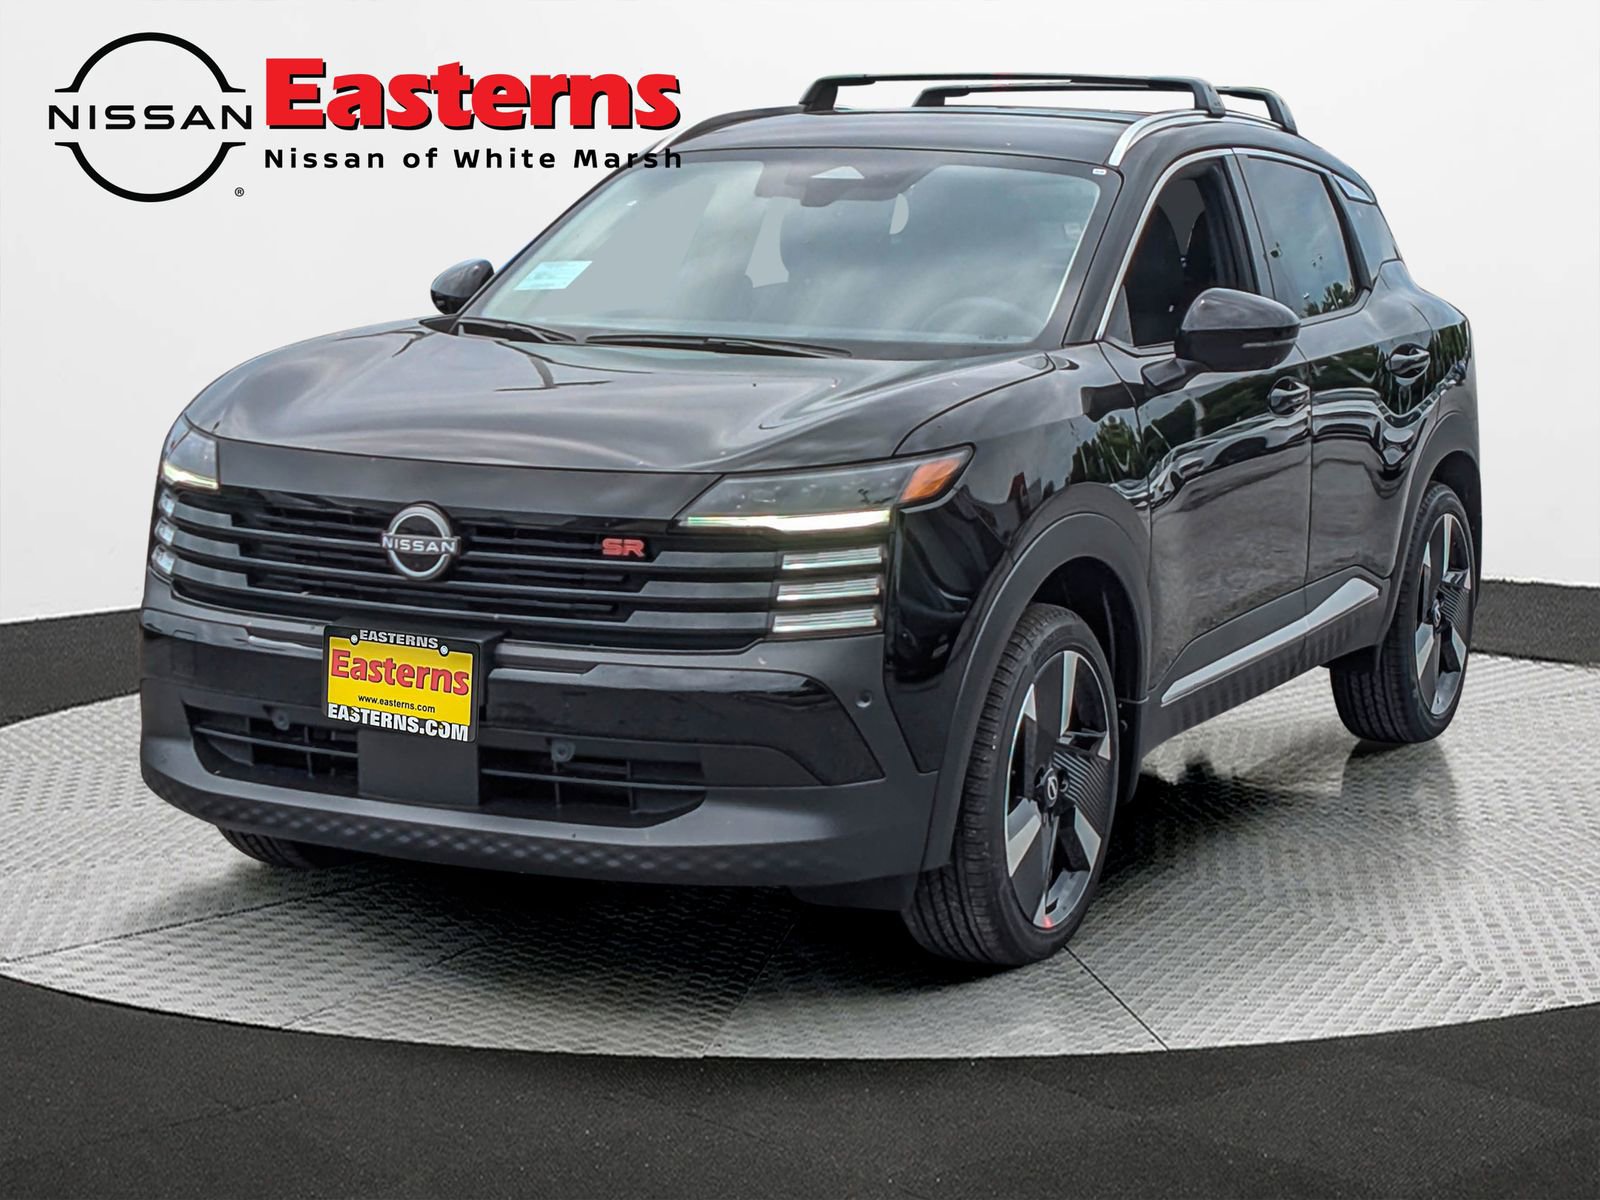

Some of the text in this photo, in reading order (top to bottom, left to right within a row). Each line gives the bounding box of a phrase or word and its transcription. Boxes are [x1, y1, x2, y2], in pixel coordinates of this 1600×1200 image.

[382, 536, 456, 552] NISSAN
[601, 537, 645, 557] SR
[359, 629, 439, 649] EASTERNS
[331, 648, 470, 696] Easterns
[358, 694, 436, 713] www.easterns.com
[327, 703, 469, 742] EASTERNS.COM
